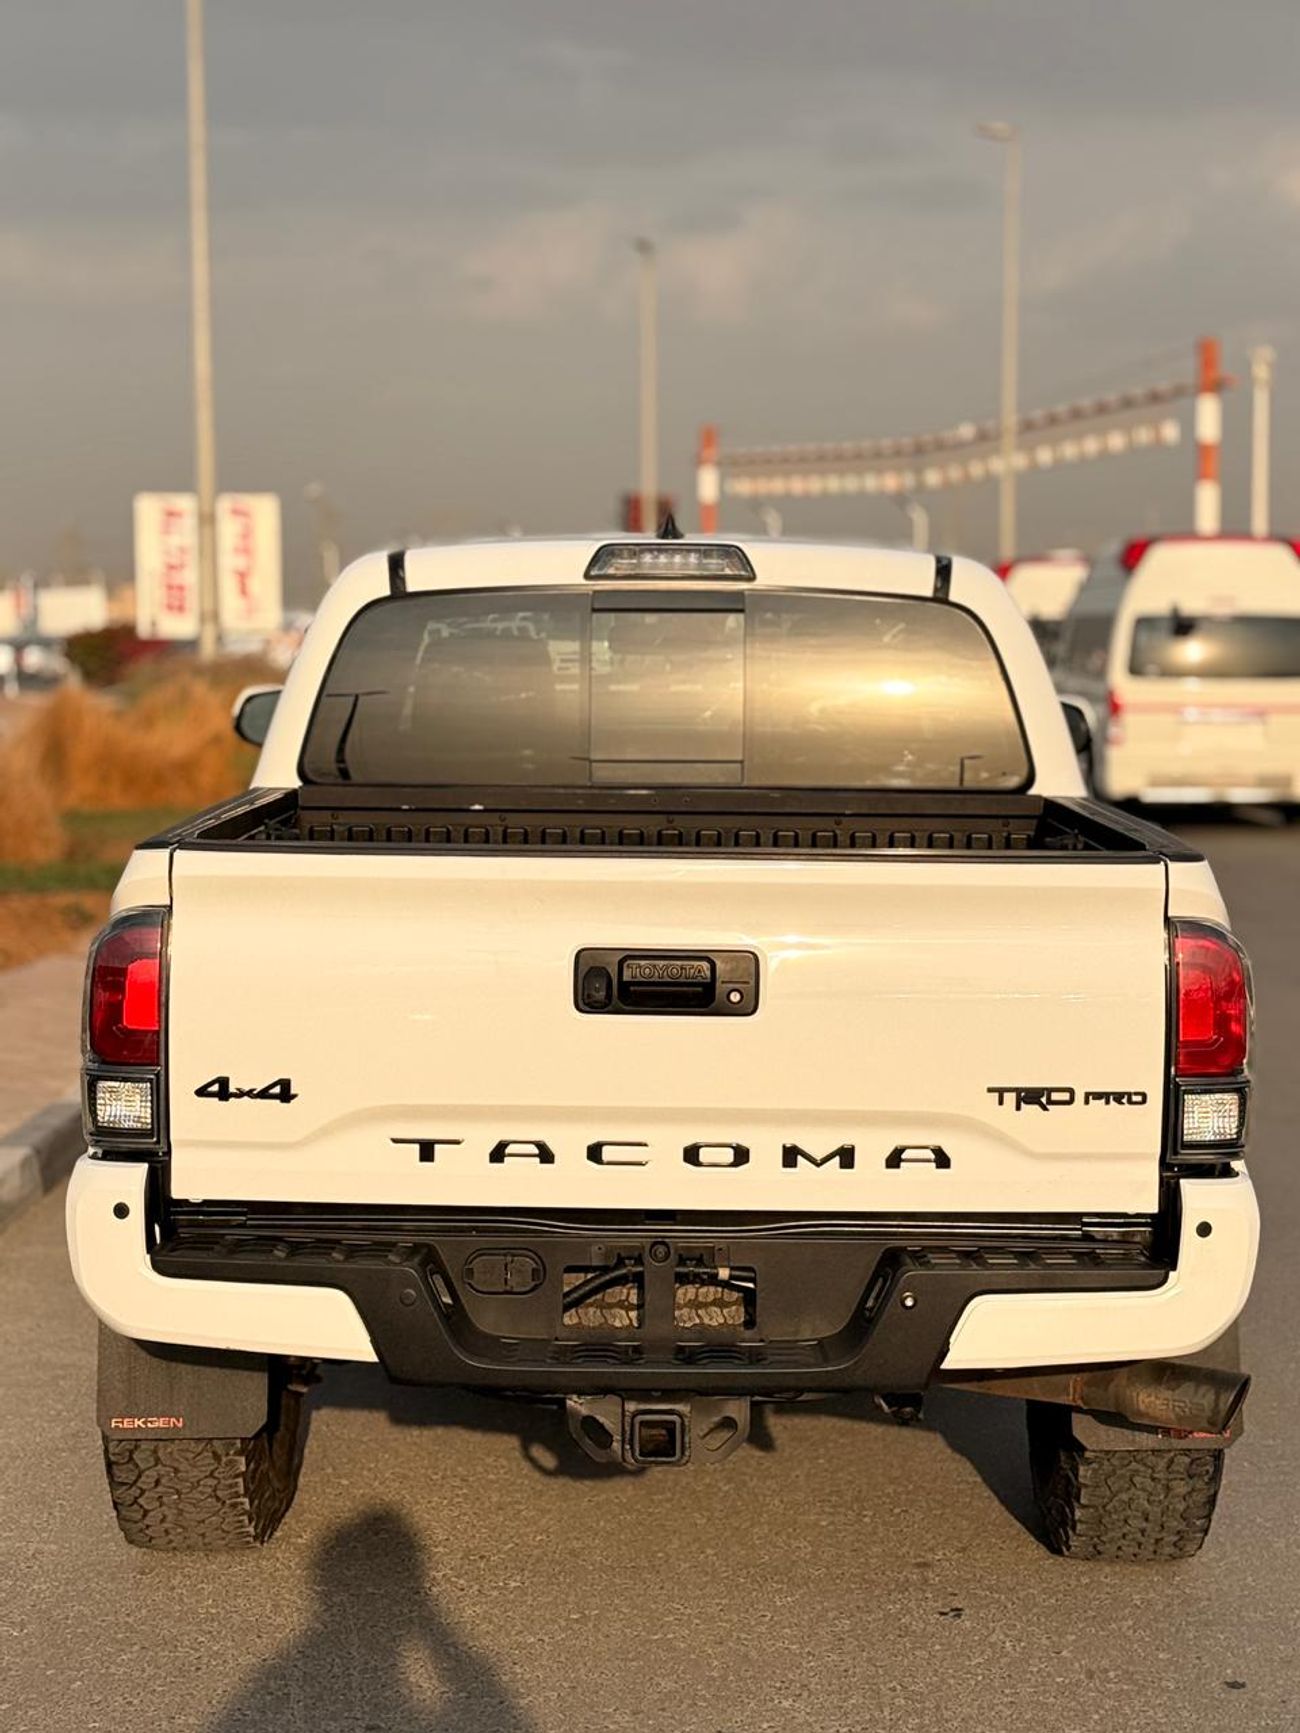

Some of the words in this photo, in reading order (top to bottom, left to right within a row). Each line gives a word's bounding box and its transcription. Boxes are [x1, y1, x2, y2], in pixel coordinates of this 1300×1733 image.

[626, 962, 708, 980] TOYOTA
[194, 1076, 299, 1103] 4x4
[986, 1087, 1075, 1111] TRD
[1084, 1091, 1148, 1105] PRO
[389, 1136, 952, 1169] TACOMA
[110, 1416, 184, 1429] REKGEN
